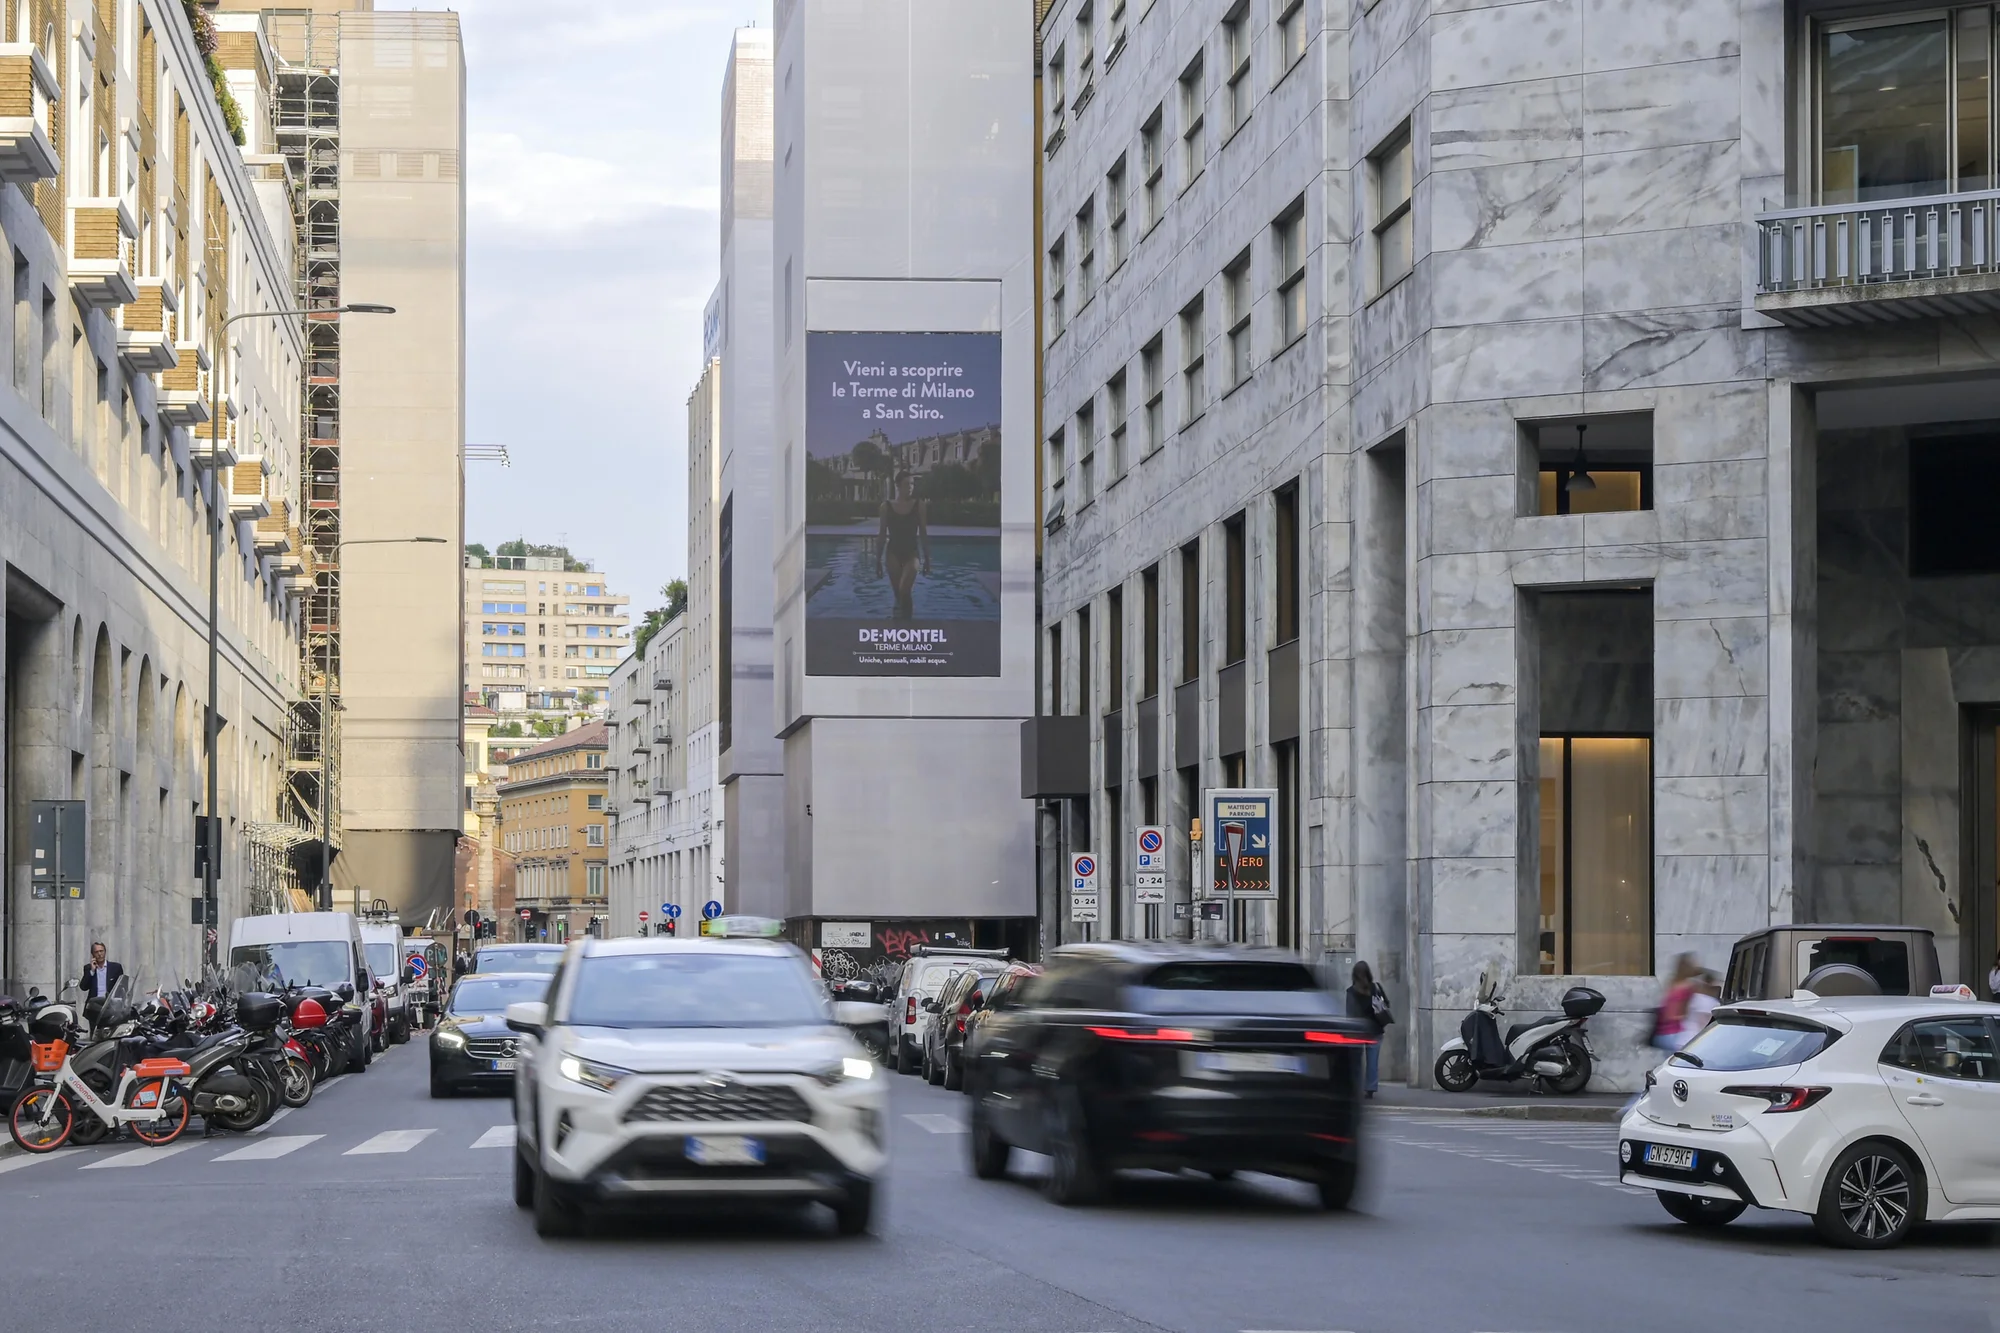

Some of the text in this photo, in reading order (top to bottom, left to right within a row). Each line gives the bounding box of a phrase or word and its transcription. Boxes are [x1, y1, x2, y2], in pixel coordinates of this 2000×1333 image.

[843, 360, 963, 382] Vieni a scoprire
[832, 382, 975, 398] le Terme di Milano
[862, 403, 944, 419] a San Siro.
[874, 643, 933, 651] TERME MILANO
[72, 1080, 96, 1104] ridemovi
